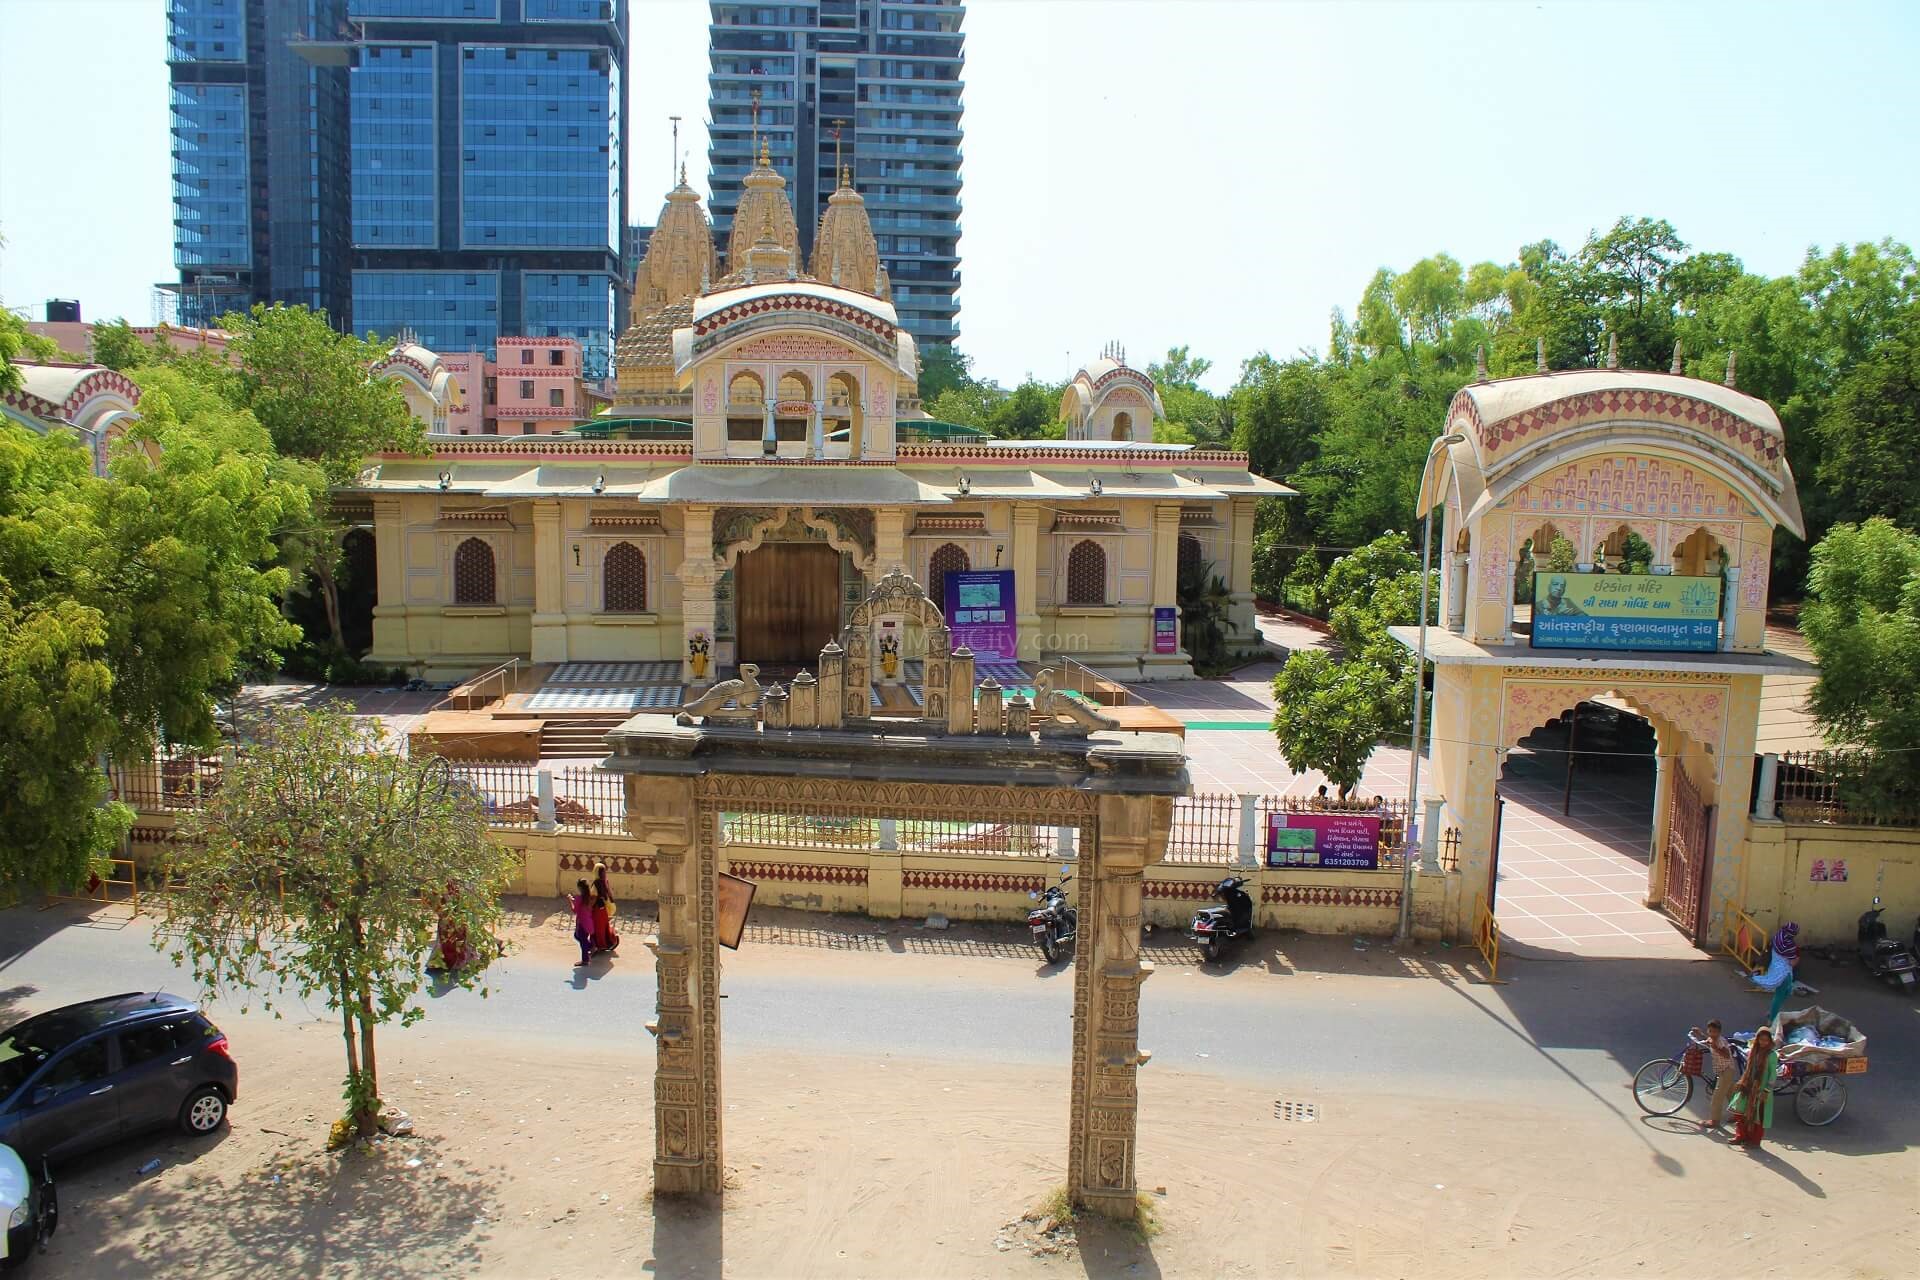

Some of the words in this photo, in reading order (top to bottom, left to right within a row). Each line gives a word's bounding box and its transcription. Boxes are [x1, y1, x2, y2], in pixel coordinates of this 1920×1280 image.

[1637, 579, 1663, 593] મંદિર
[1583, 595, 1596, 608] શ્રી
[1693, 622, 1713, 635] સંઘ
[1324, 858, 1369, 866] 6351203709
